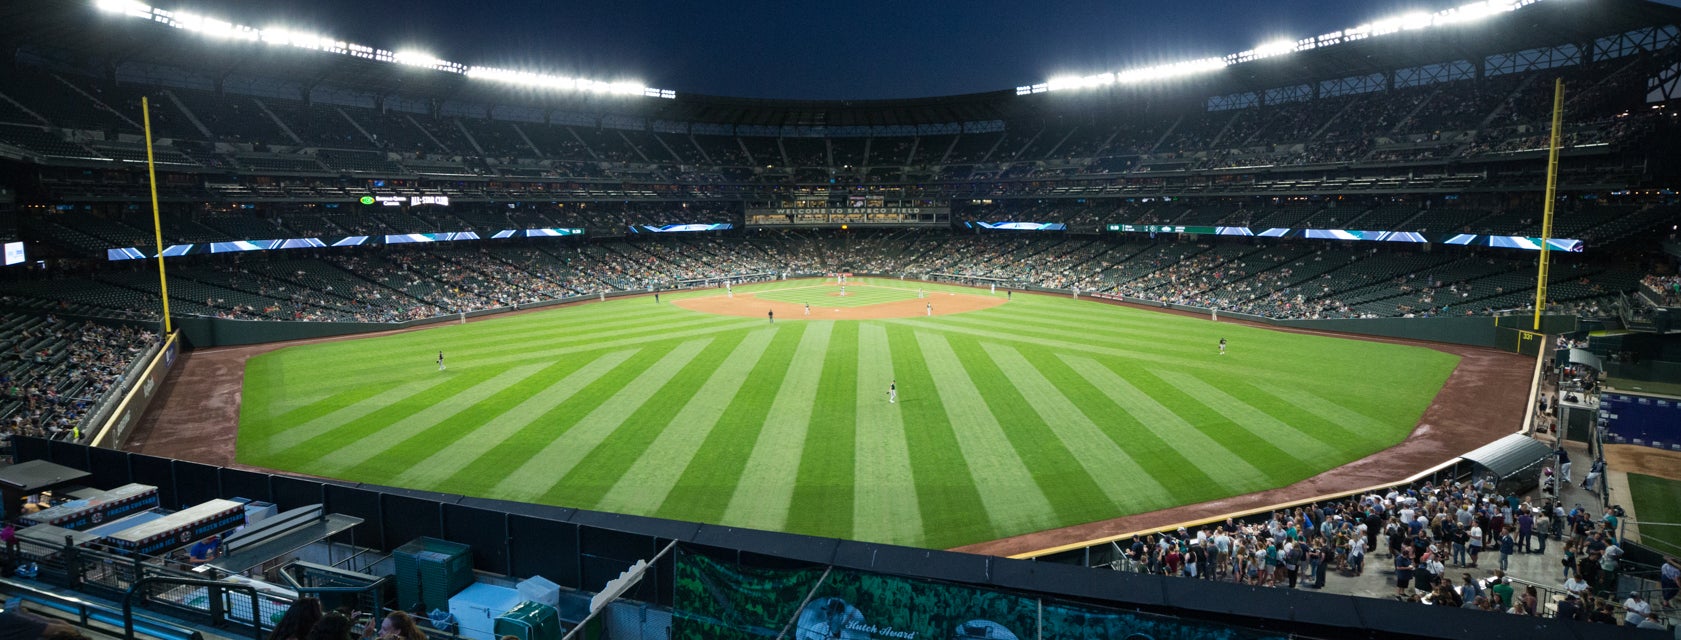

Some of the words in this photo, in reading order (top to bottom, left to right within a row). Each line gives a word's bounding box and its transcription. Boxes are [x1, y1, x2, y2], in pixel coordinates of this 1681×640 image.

[107, 504, 130, 516] FROZEN
[195, 522, 218, 535] FROZEN
[218, 514, 244, 527] CUSTARD
[845, 620, 878, 633] Hutch
[879, 626, 915, 640] Award
